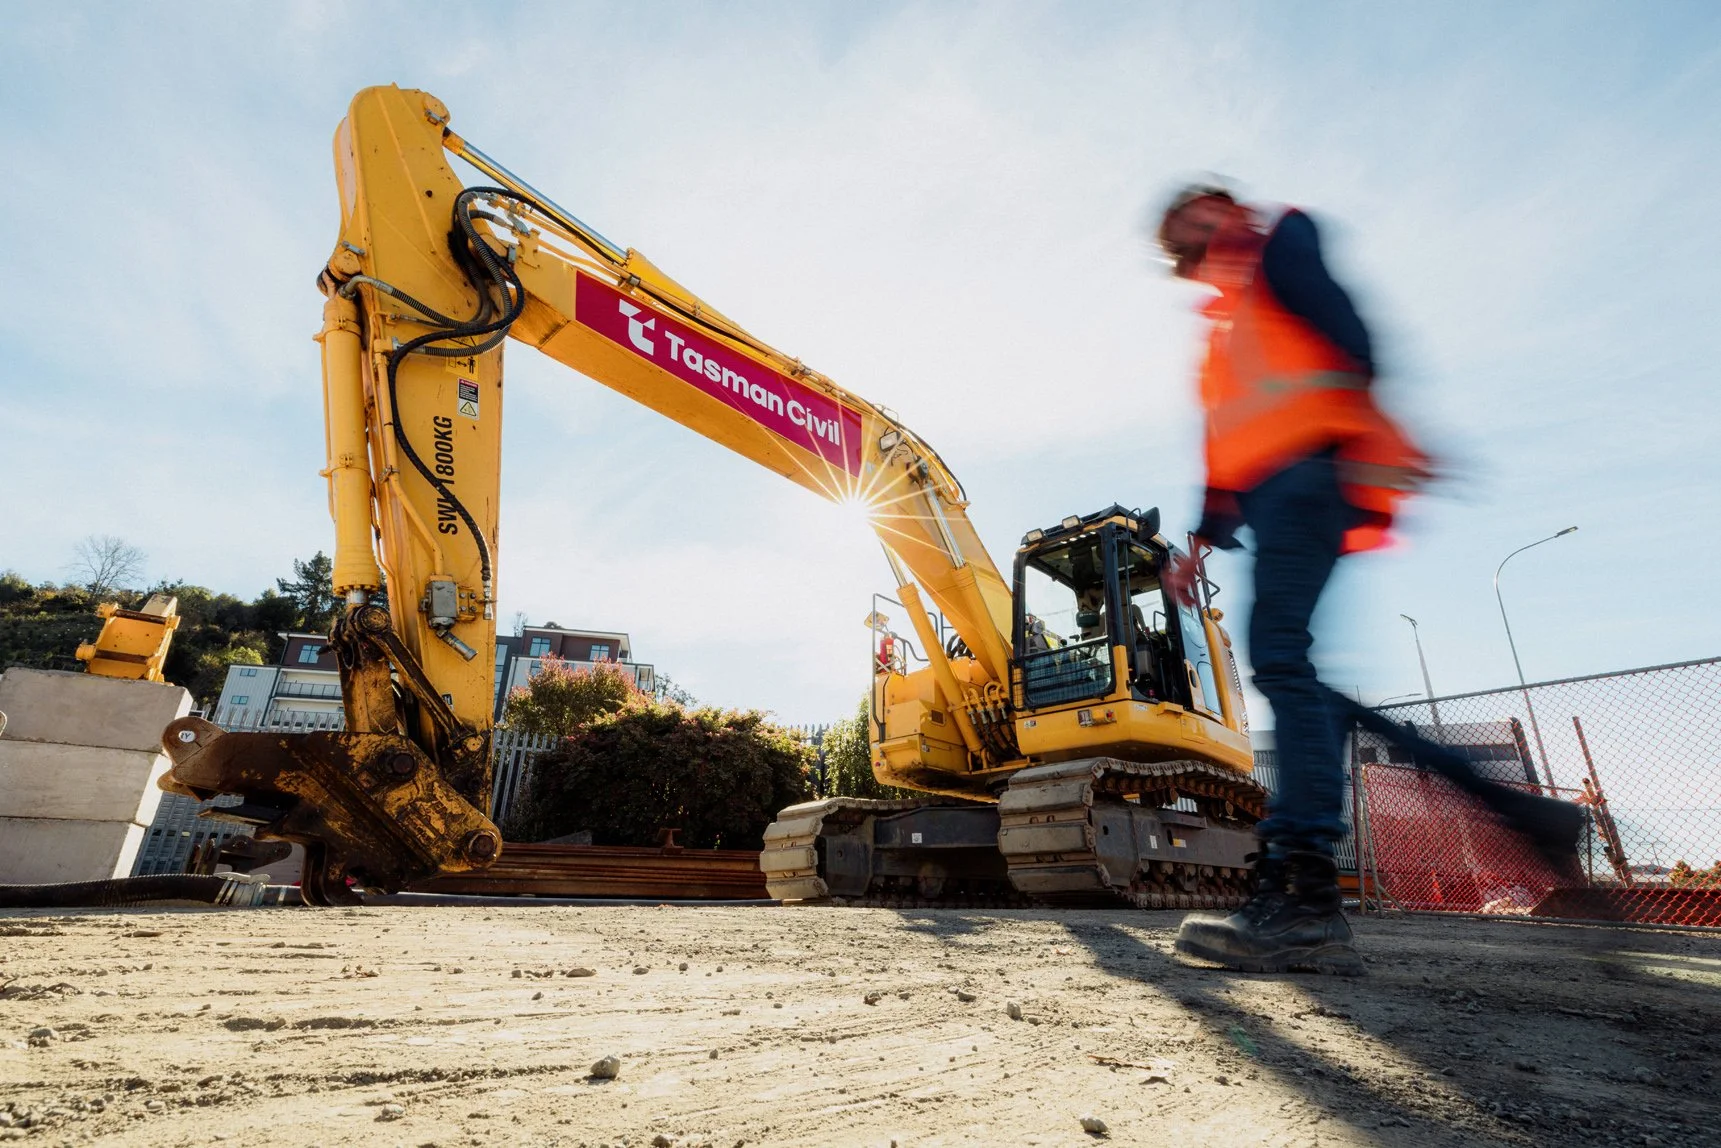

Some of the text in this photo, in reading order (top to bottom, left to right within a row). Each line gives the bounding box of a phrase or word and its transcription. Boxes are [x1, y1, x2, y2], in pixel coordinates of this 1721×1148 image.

[664, 330, 840, 446] Tasman Civil
[433, 415, 455, 485] 1800KG
